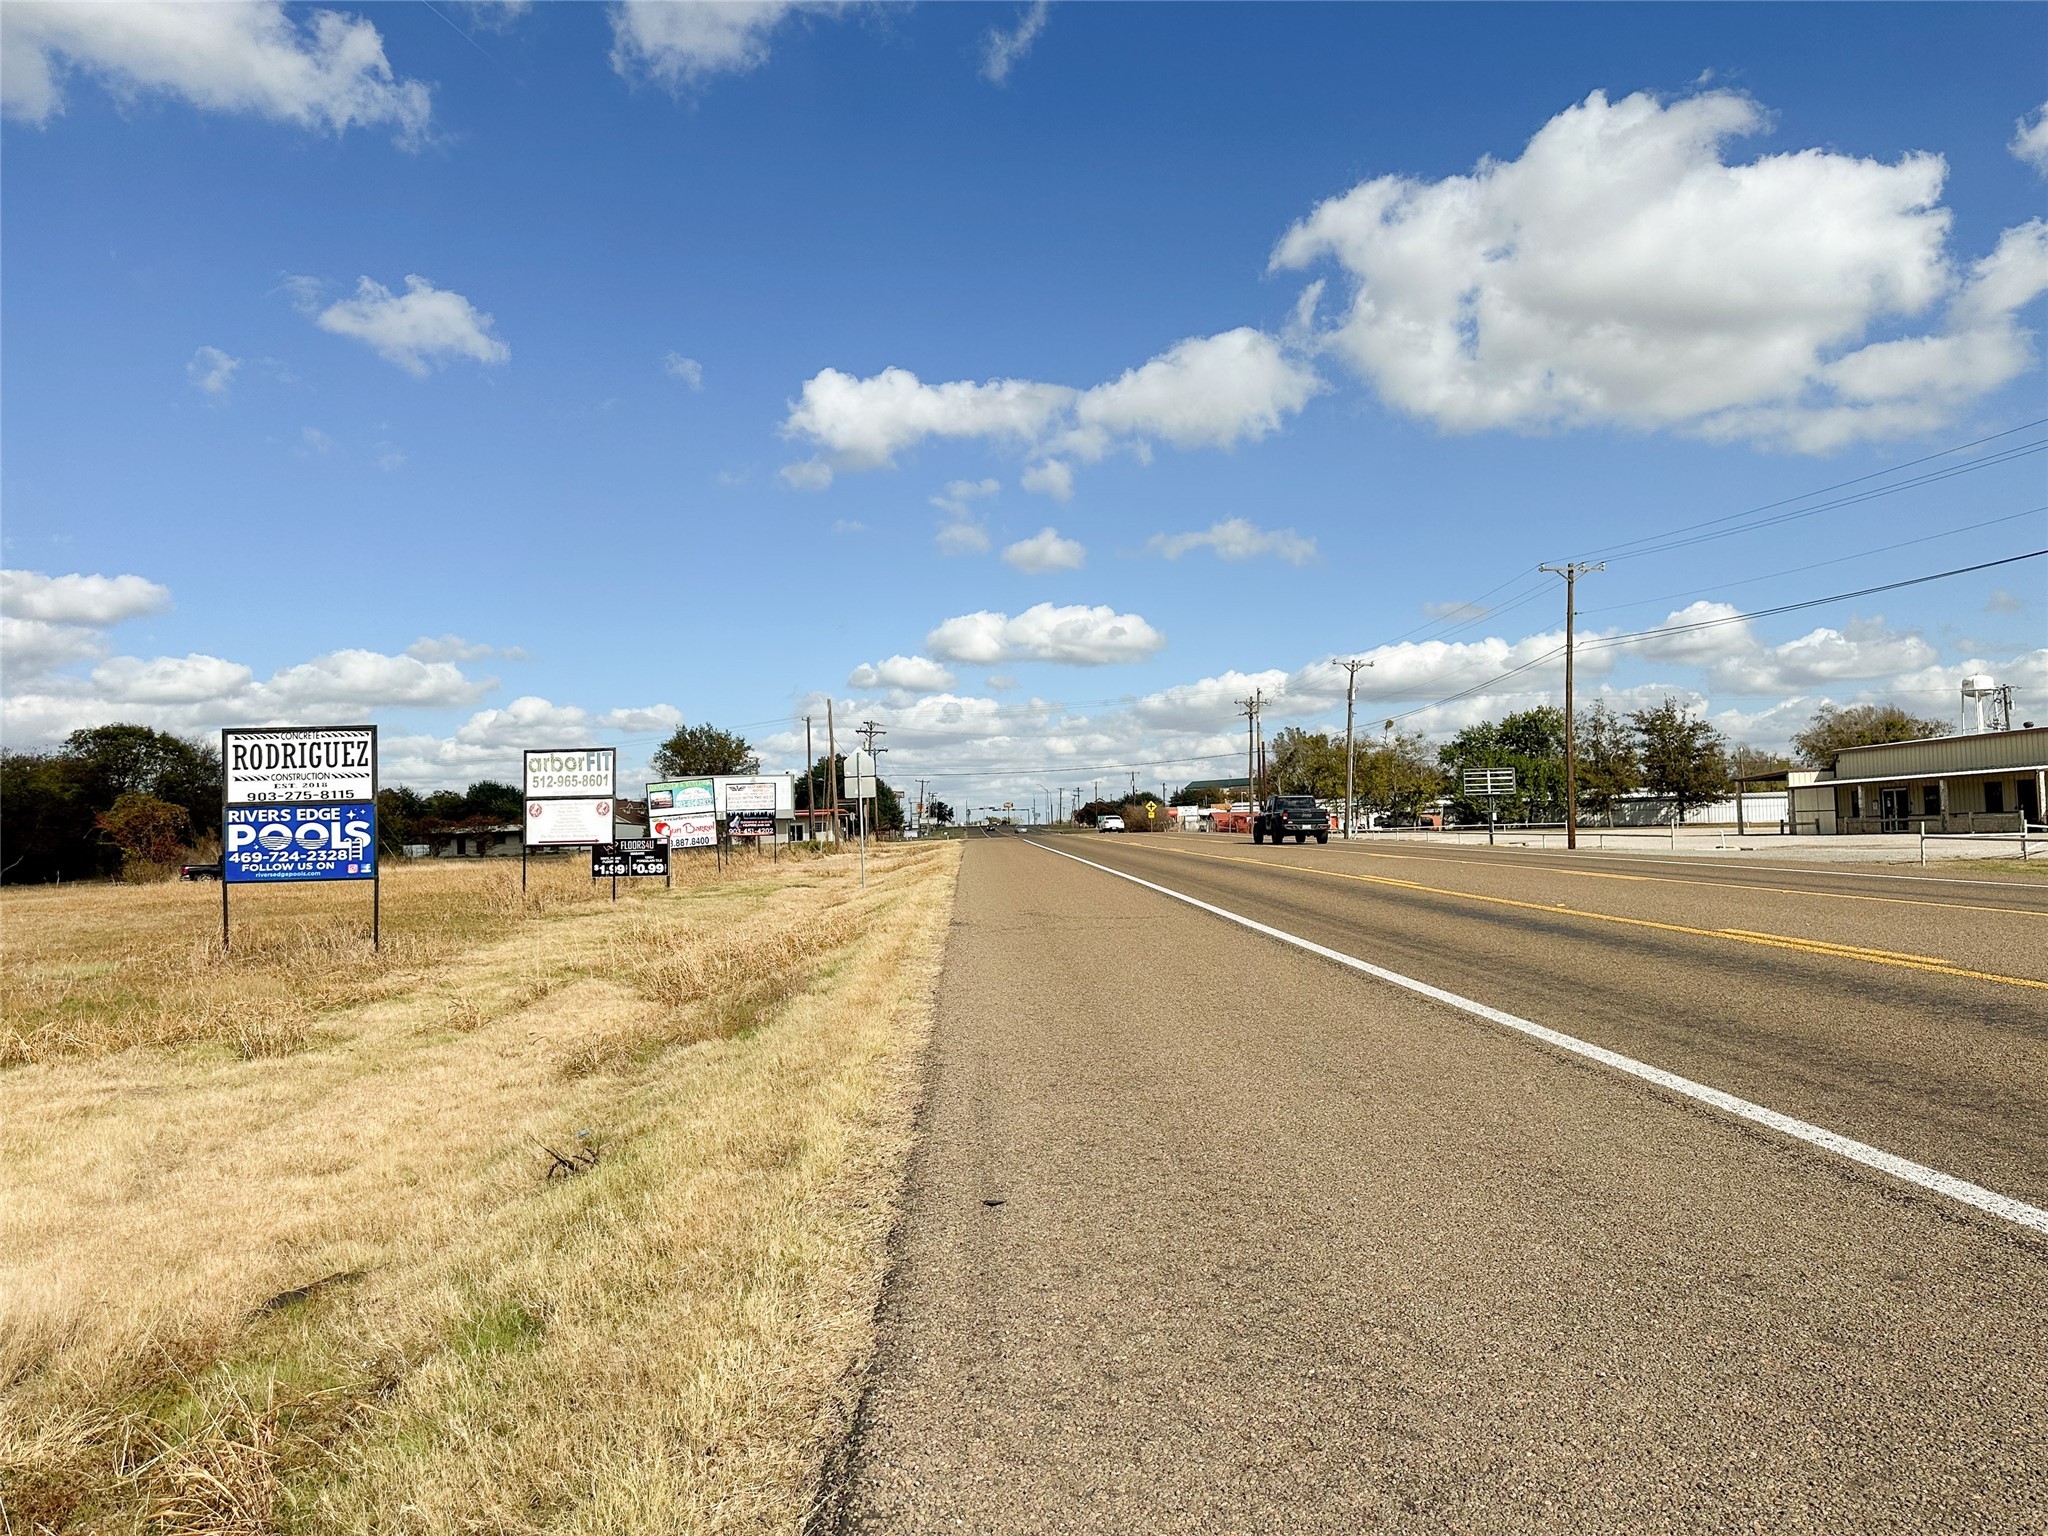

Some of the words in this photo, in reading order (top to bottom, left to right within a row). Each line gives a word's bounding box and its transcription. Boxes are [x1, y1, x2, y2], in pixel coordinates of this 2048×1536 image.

[280, 731, 320, 741] CONCRETE
[232, 740, 369, 771] RODRIGUEZ
[270, 772, 331, 781] CONSTRUCTION
[247, 790, 355, 801] 903-275-8115
[228, 809, 292, 823] RIVERS
[296, 808, 341, 821] EDGE
[228, 820, 371, 851] POOLS
[620, 840, 655, 850] FLOORS4U
[228, 850, 348, 863] 469-724-2328
[242, 863, 295, 872] FOLLOW
[297, 863, 313, 871] US
[316, 862, 335, 870] ON
[632, 863, 664, 874] $0.99
